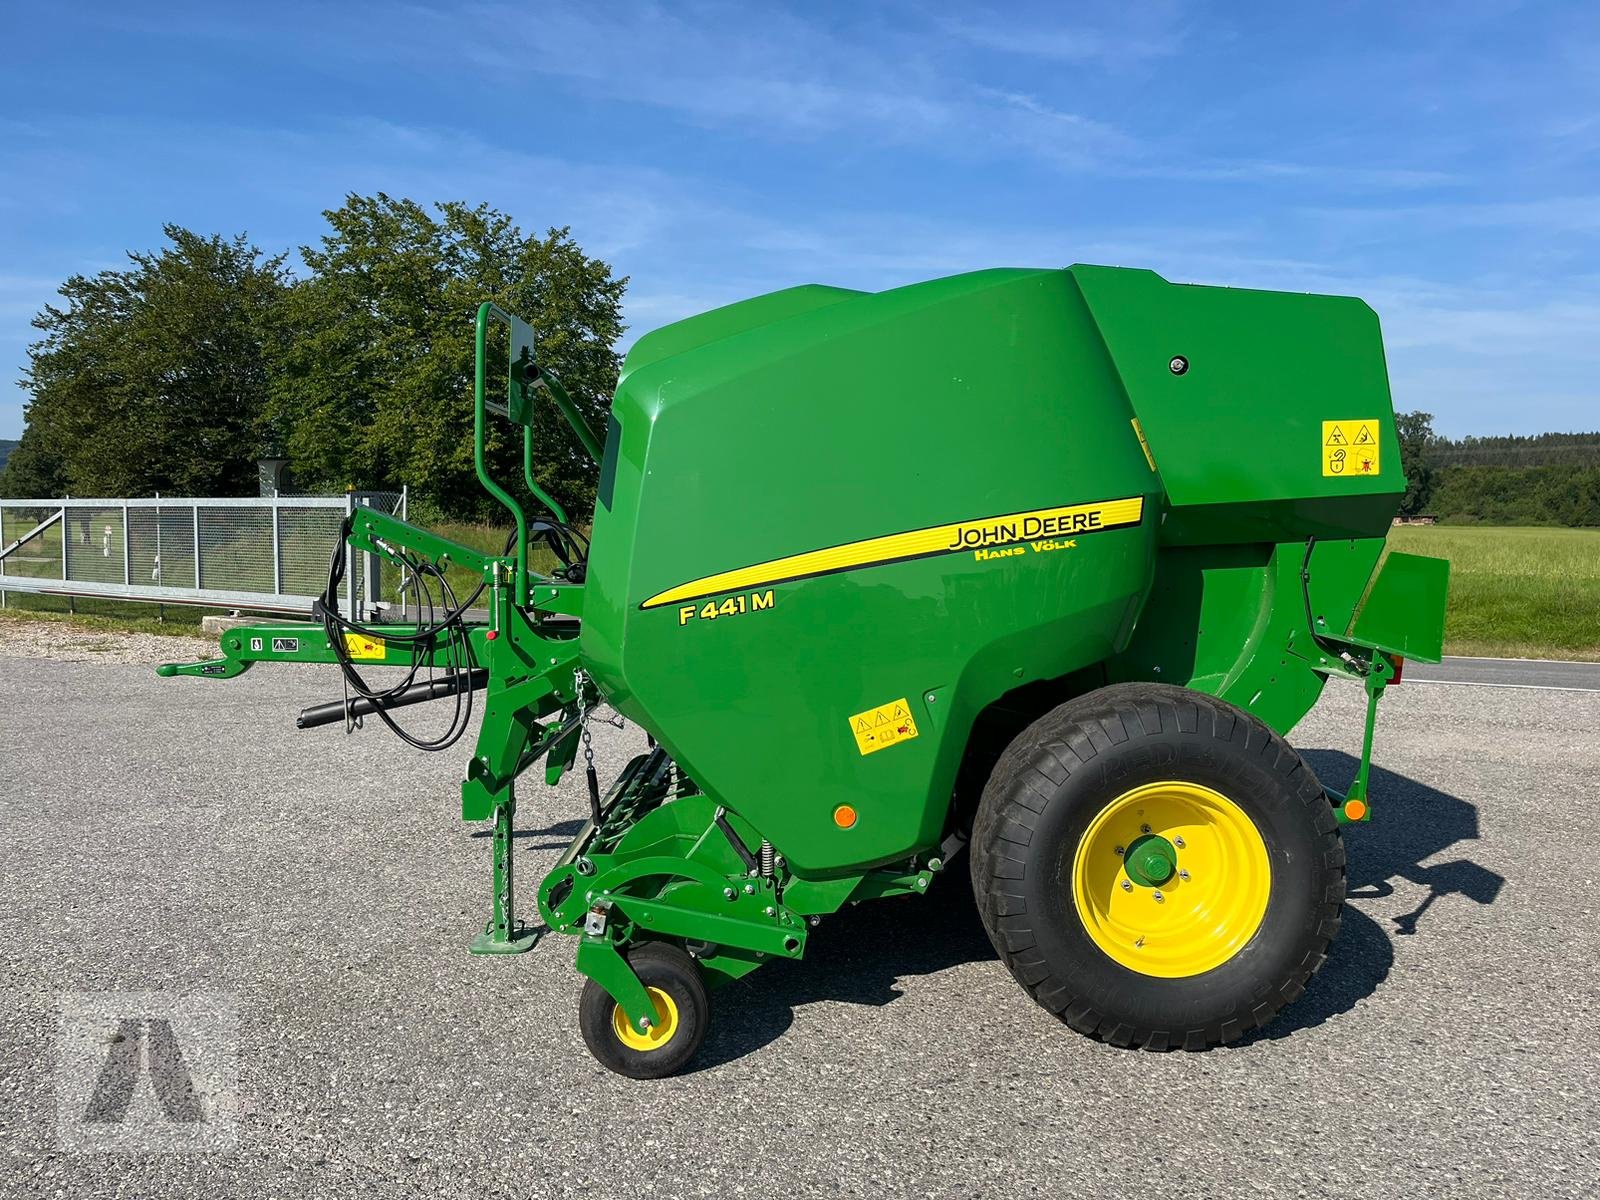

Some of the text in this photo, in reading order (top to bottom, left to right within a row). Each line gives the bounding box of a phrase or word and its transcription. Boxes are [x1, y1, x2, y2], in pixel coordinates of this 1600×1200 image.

[949, 511, 1101, 548] JOHN DEERE
[974, 547, 1025, 561] HANS
[679, 589, 775, 626] F 441 M
